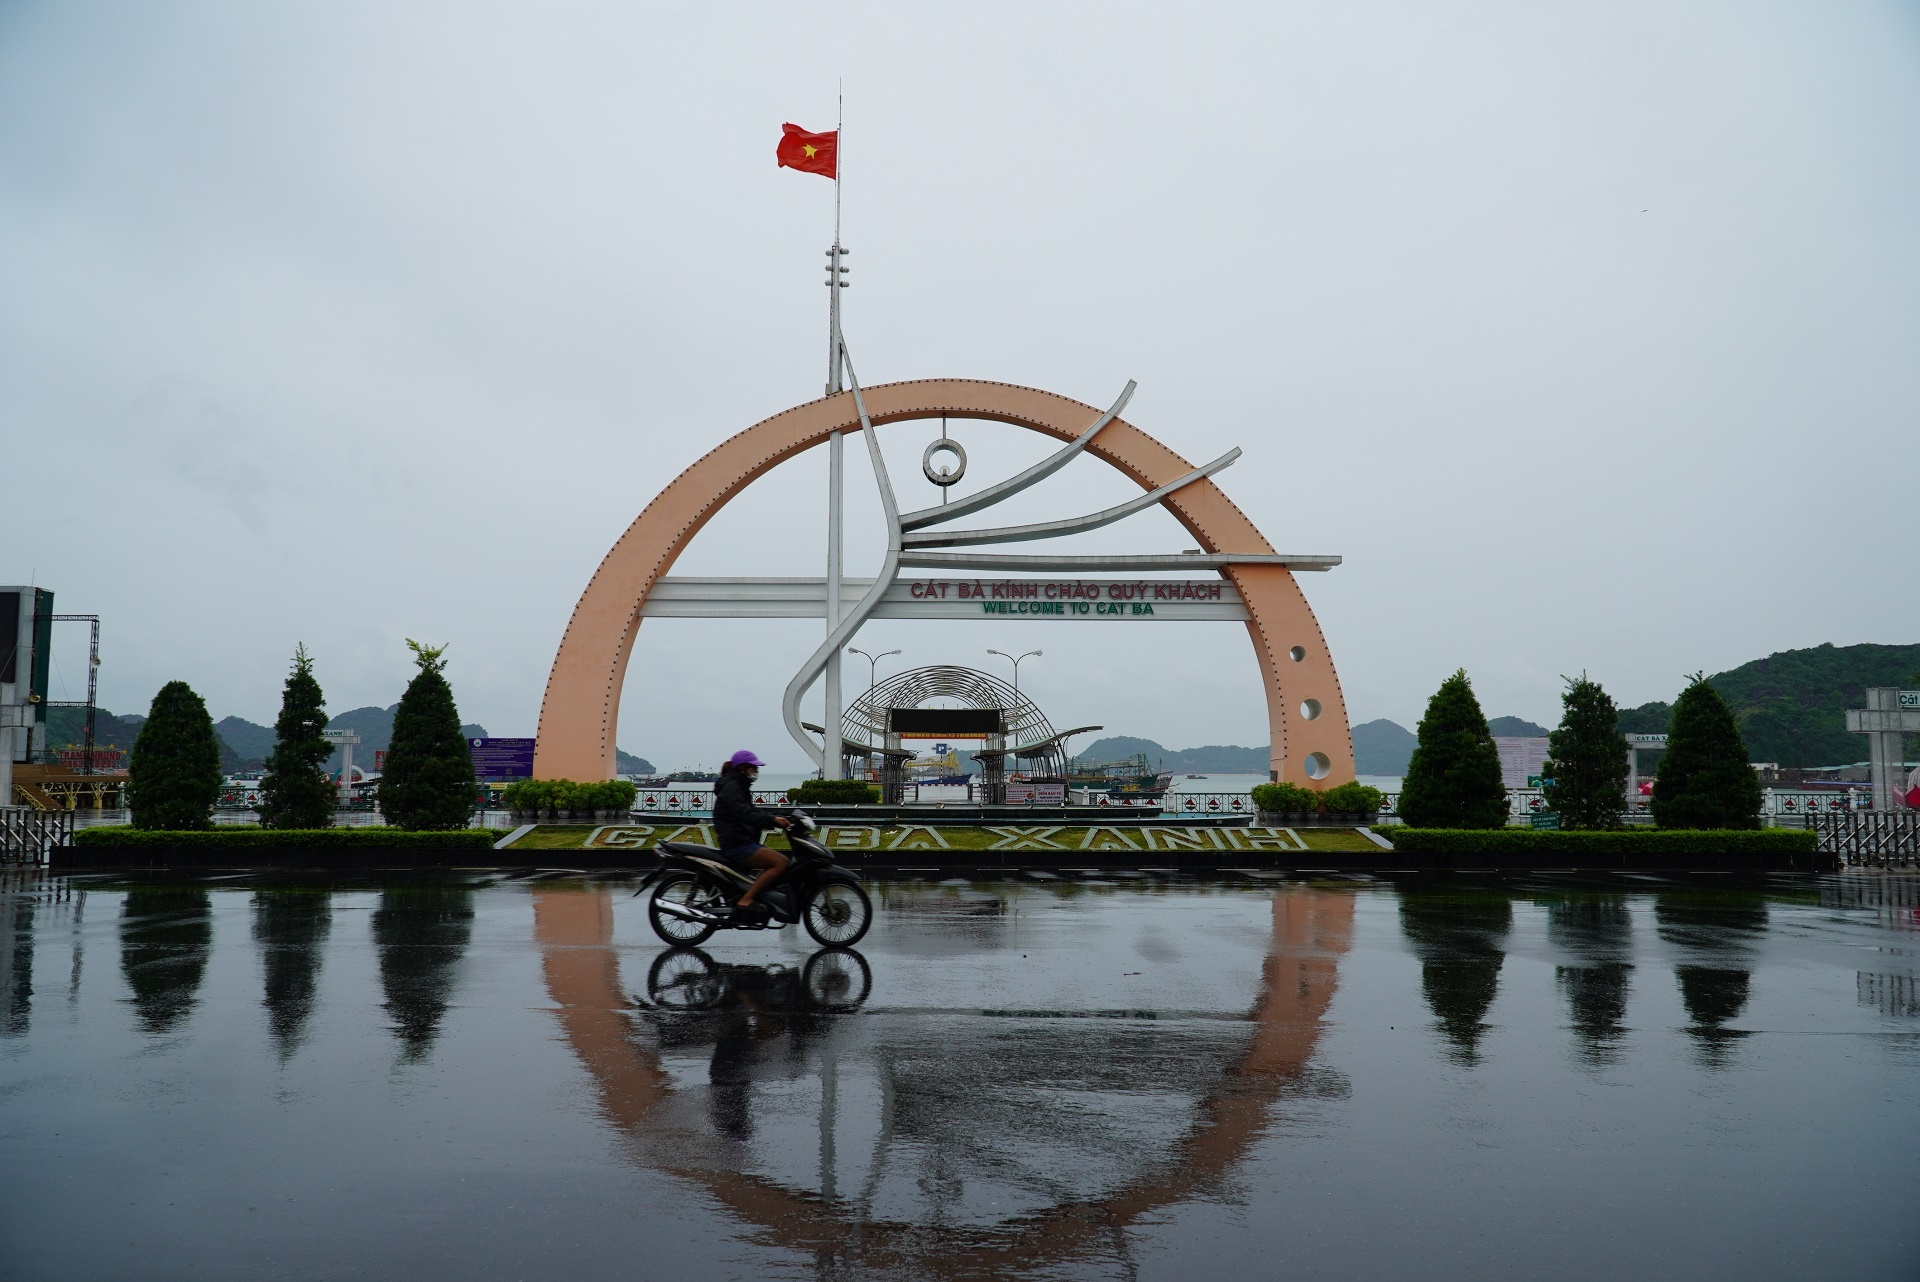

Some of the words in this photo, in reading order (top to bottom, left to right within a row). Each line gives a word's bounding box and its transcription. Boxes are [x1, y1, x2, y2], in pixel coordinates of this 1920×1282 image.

[911, 579, 949, 599] CÁT
[958, 579, 985, 599] BÀ
[992, 579, 1038, 599] KÍNH
[1044, 580, 1100, 600] CHÀO
[1108, 580, 1149, 600] QUÝ
[1154, 580, 1221, 600] KHÁCH
[983, 601, 1065, 615] WELCOME
[1070, 601, 1090, 615] TO
[1096, 601, 1127, 615] CAT
[1132, 602, 1154, 615] BA
[1900, 694, 1917, 704] Cát
[981, 826, 1310, 851] XANH
